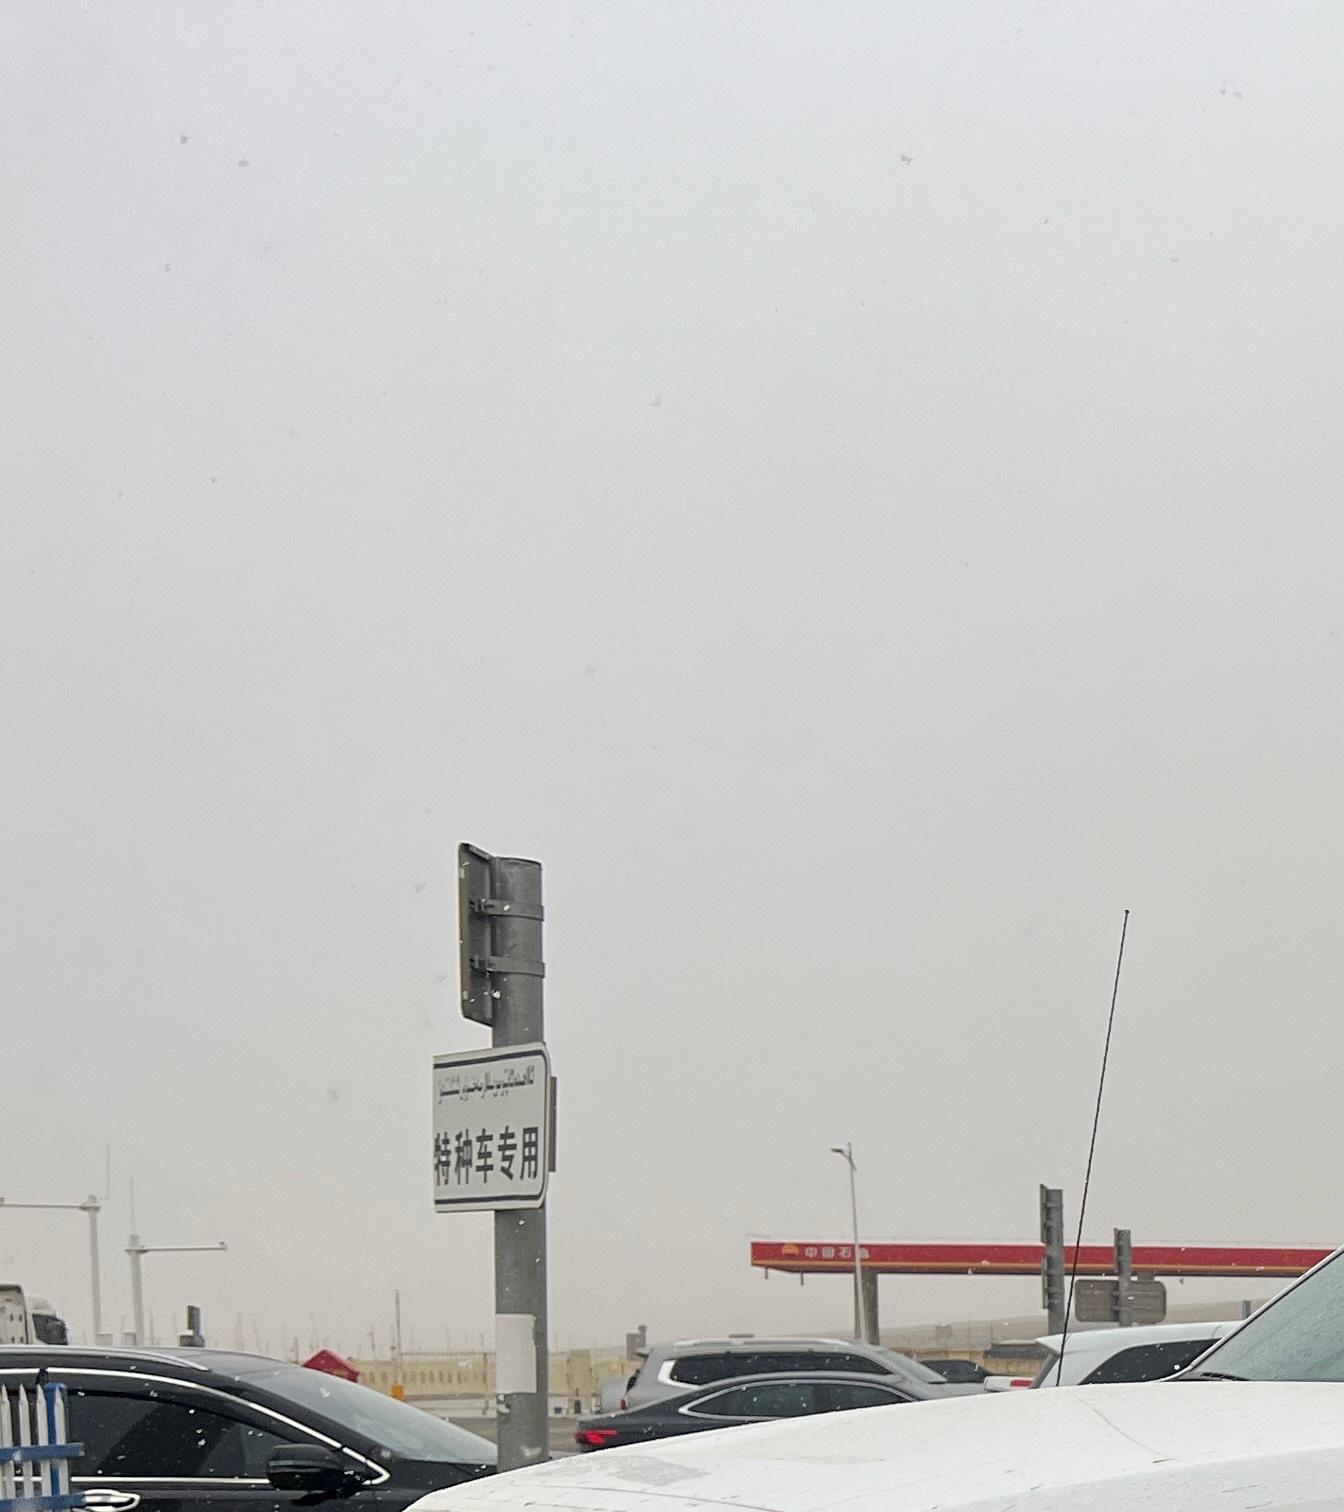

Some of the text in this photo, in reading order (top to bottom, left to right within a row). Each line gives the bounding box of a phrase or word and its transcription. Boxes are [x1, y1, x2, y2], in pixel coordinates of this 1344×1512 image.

[433, 1125, 539, 1187] 特种车专用
